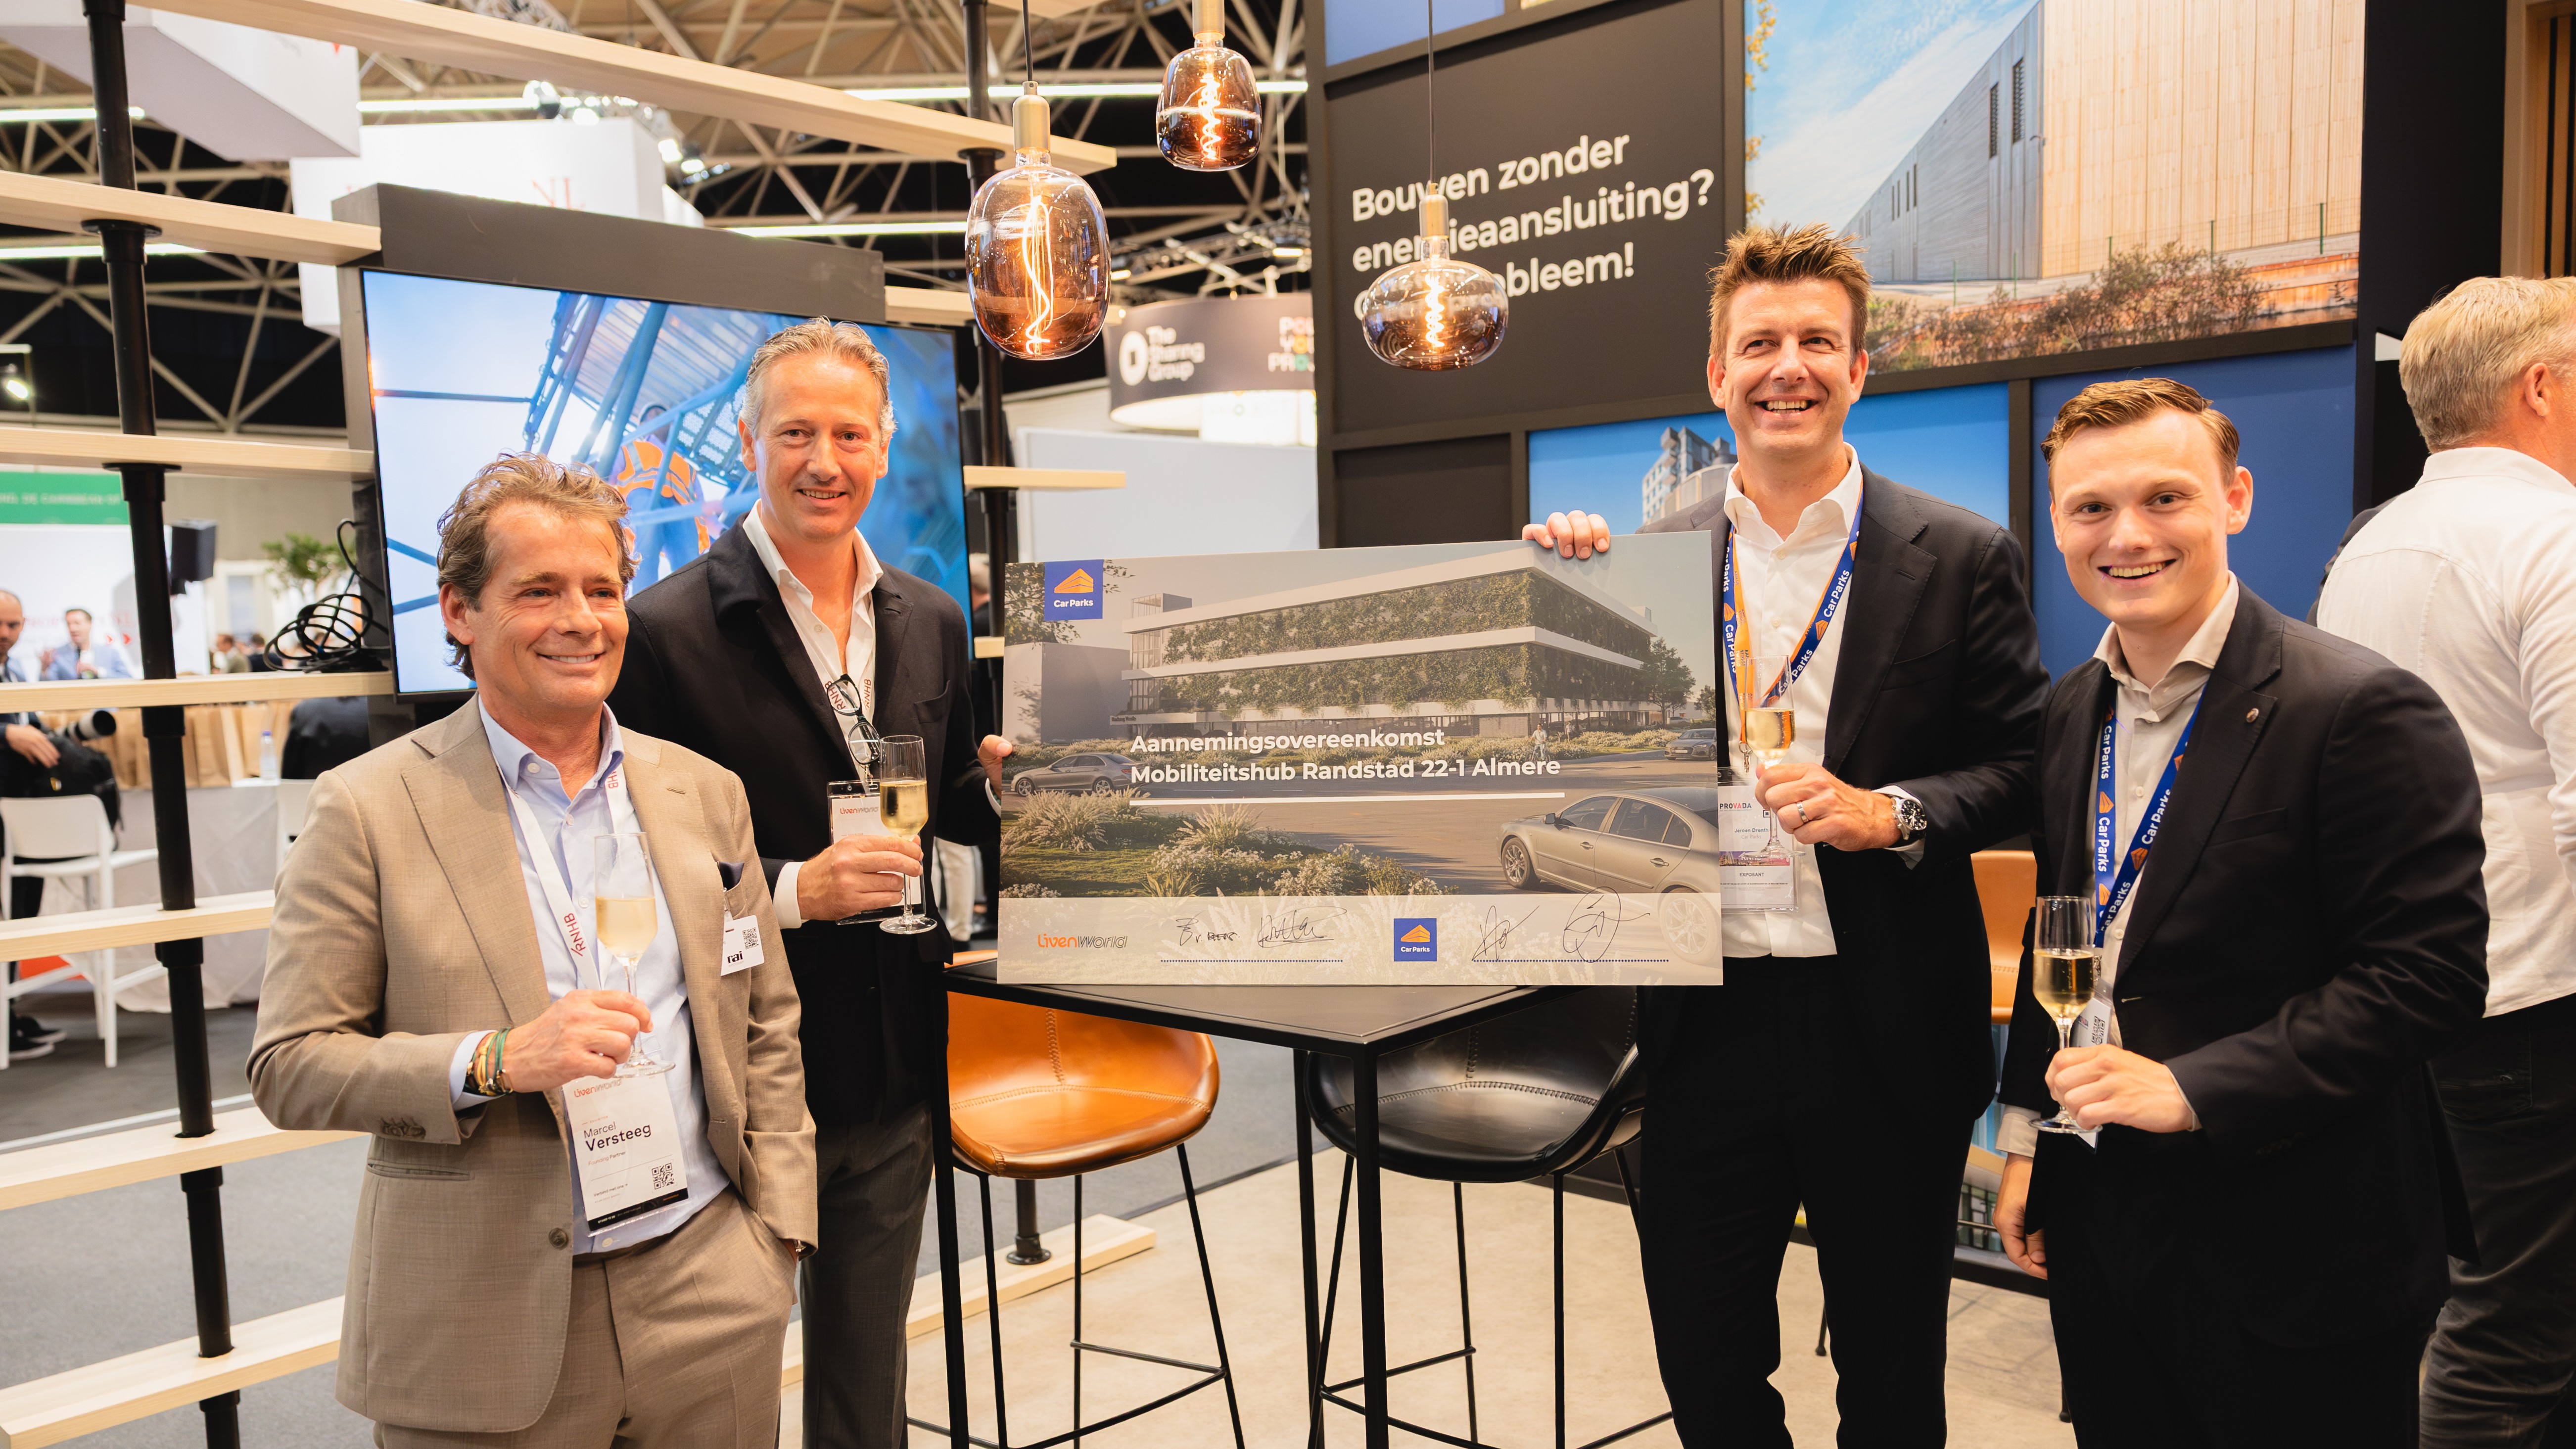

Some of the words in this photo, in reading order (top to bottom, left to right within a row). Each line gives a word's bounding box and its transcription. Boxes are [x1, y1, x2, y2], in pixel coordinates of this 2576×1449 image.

[1498, 134, 1630, 190] zonder
[1353, 168, 1715, 272] enerieaansluiting?
[1146, 326, 1176, 345] The
[1148, 361, 1195, 381] Group
[1070, 599, 1094, 607] Parks
[1824, 598, 1837, 617] Car
[1831, 569, 1850, 600] Parks
[1725, 624, 1734, 644] Car
[1791, 649, 1813, 678] Parks
[1130, 729, 1445, 754] Aannemingsovereenkomst
[2103, 725, 2112, 745] Car
[1131, 762, 1296, 783] Mobiliteitshub
[1303, 759, 1414, 780] Randstad
[1421, 759, 1465, 778] 22-1
[1472, 757, 1560, 777] Almere
[2101, 746, 2111, 779] Parks
[2098, 817, 2110, 838] Car
[2142, 823, 2158, 844] Car
[2098, 839, 2110, 872] Parks
[2109, 882, 2131, 913] Parks
[1037, 933, 1128, 948] LivenWorld
[727, 951, 743, 964] rai
[574, 1078, 622, 1098] LivenWorld
[583, 1122, 616, 1139] Marcel
[585, 1124, 652, 1152] Versteeg
[609, 1151, 626, 1159] Partner
